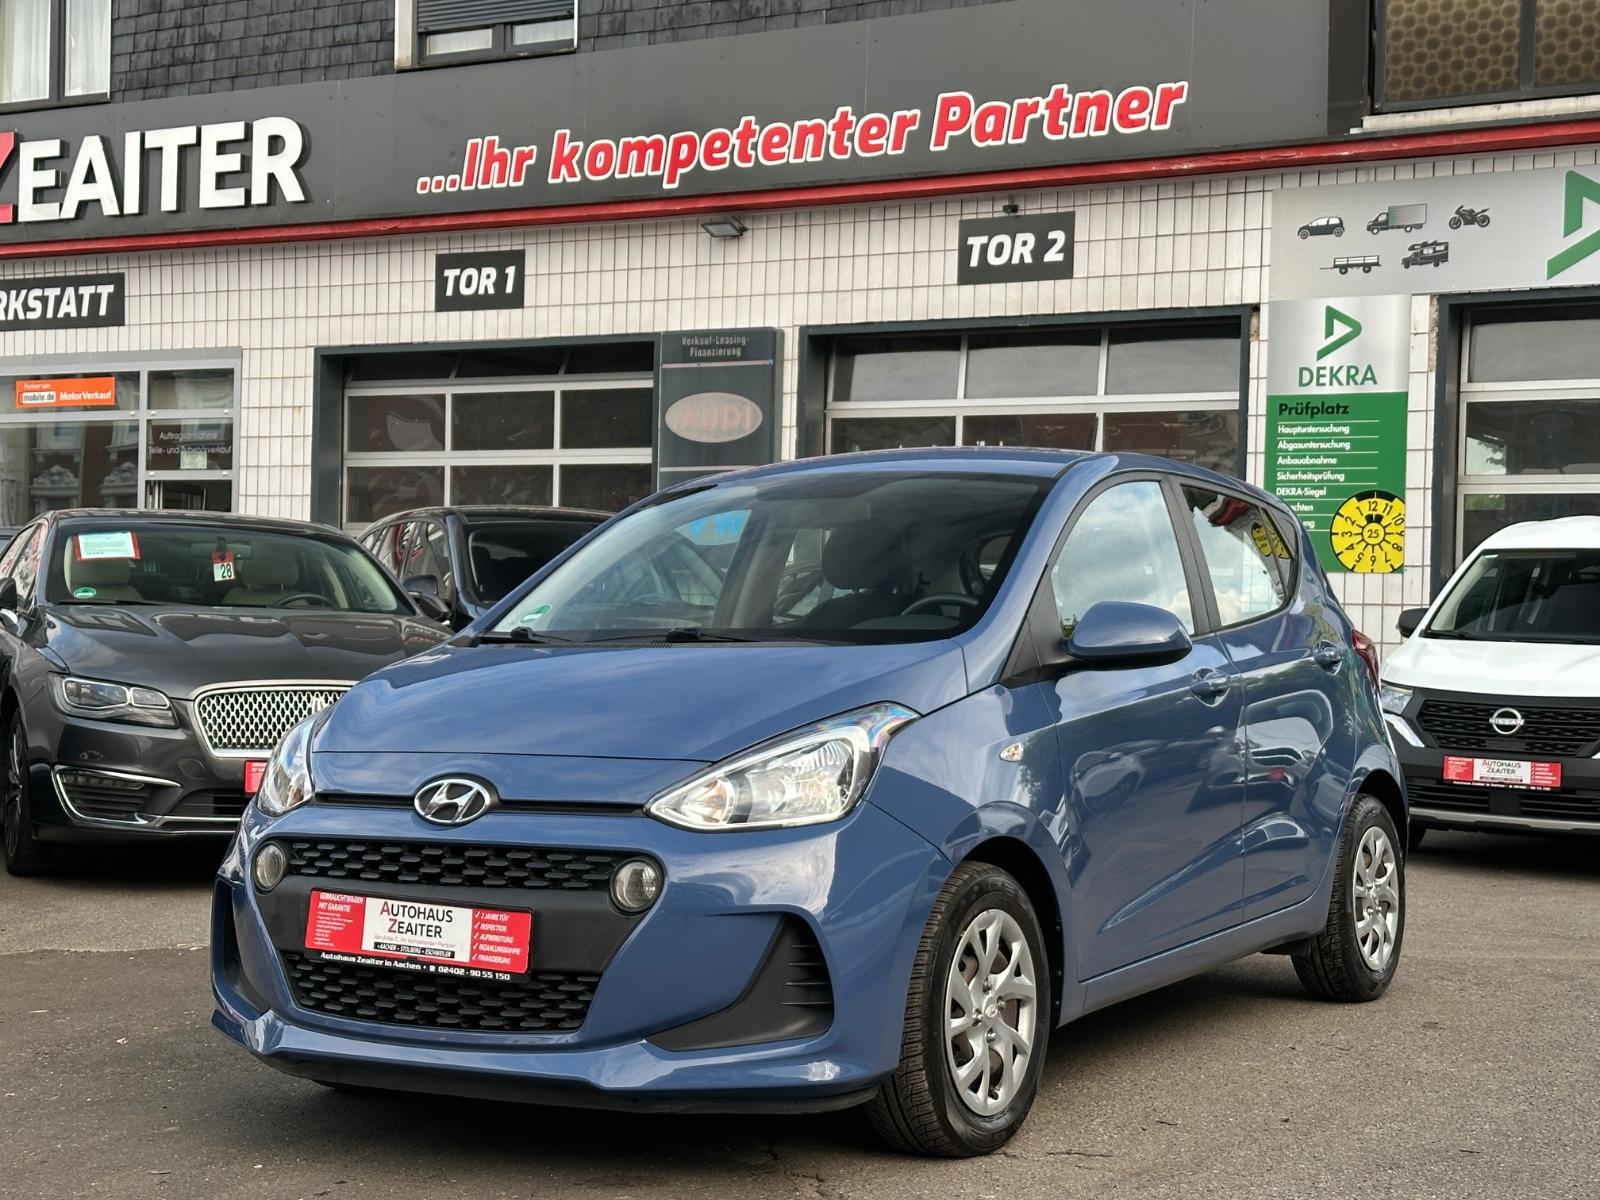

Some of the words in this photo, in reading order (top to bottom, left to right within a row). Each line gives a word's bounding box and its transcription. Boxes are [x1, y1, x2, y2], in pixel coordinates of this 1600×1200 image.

[548, 107, 920, 189] kompetenter
[930, 81, 1188, 151] Partner
[0, 116, 305, 223] EAITER
[967, 233, 1036, 267] TOR
[1043, 230, 1066, 262] 2
[443, 267, 497, 296] TOR
[504, 266, 516, 294] 1
[690, 347, 742, 357] Finanzierung
[1298, 364, 1378, 387] DEKRA
[23, 393, 54, 402] mobile.de
[60, 391, 112, 400] MotorVerkauf
[1279, 401, 1350, 418] Prüfplatz
[677, 402, 753, 432] AUDI
[1278, 424, 1350, 435] Hauptuntersuchung
[1277, 440, 1350, 451] Abgasuntersuchung
[1277, 456, 1337, 464] Anbauabnahme
[1276, 471, 1344, 481] Sicherheitsprüfung
[1276, 487, 1327, 497] DEKRA-Siegel
[1356, 506, 1364, 516] 1
[1368, 501, 1378, 512] 12
[1383, 503, 1393, 515] 11
[1344, 516, 1356, 525] 2
[1392, 512, 1405, 525] 10
[1367, 530, 1379, 538] 25
[1345, 543, 1355, 551] 4
[1391, 543, 1403, 552] 8
[1355, 552, 1364, 563] 5
[1371, 555, 1376, 566] 6
[1384, 551, 1391, 563] 7
[220, 562, 233, 579] 28
[1489, 717, 1525, 726] NISSAN
[1482, 760, 1521, 768] AUTOHAUS
[1486, 767, 1516, 775] ZEAITER
[319, 892, 364, 904] GEBRAUCHTWAGEN
[380, 901, 453, 923] AUTOHAUS
[388, 918, 443, 938] ZEAITER
[320, 952, 356, 962] Autohaus
[357, 956, 384, 966] Zeaiter
[385, 959, 392, 967] in
[392, 960, 421, 970] Aachen
[438, 964, 465, 975] 02402
